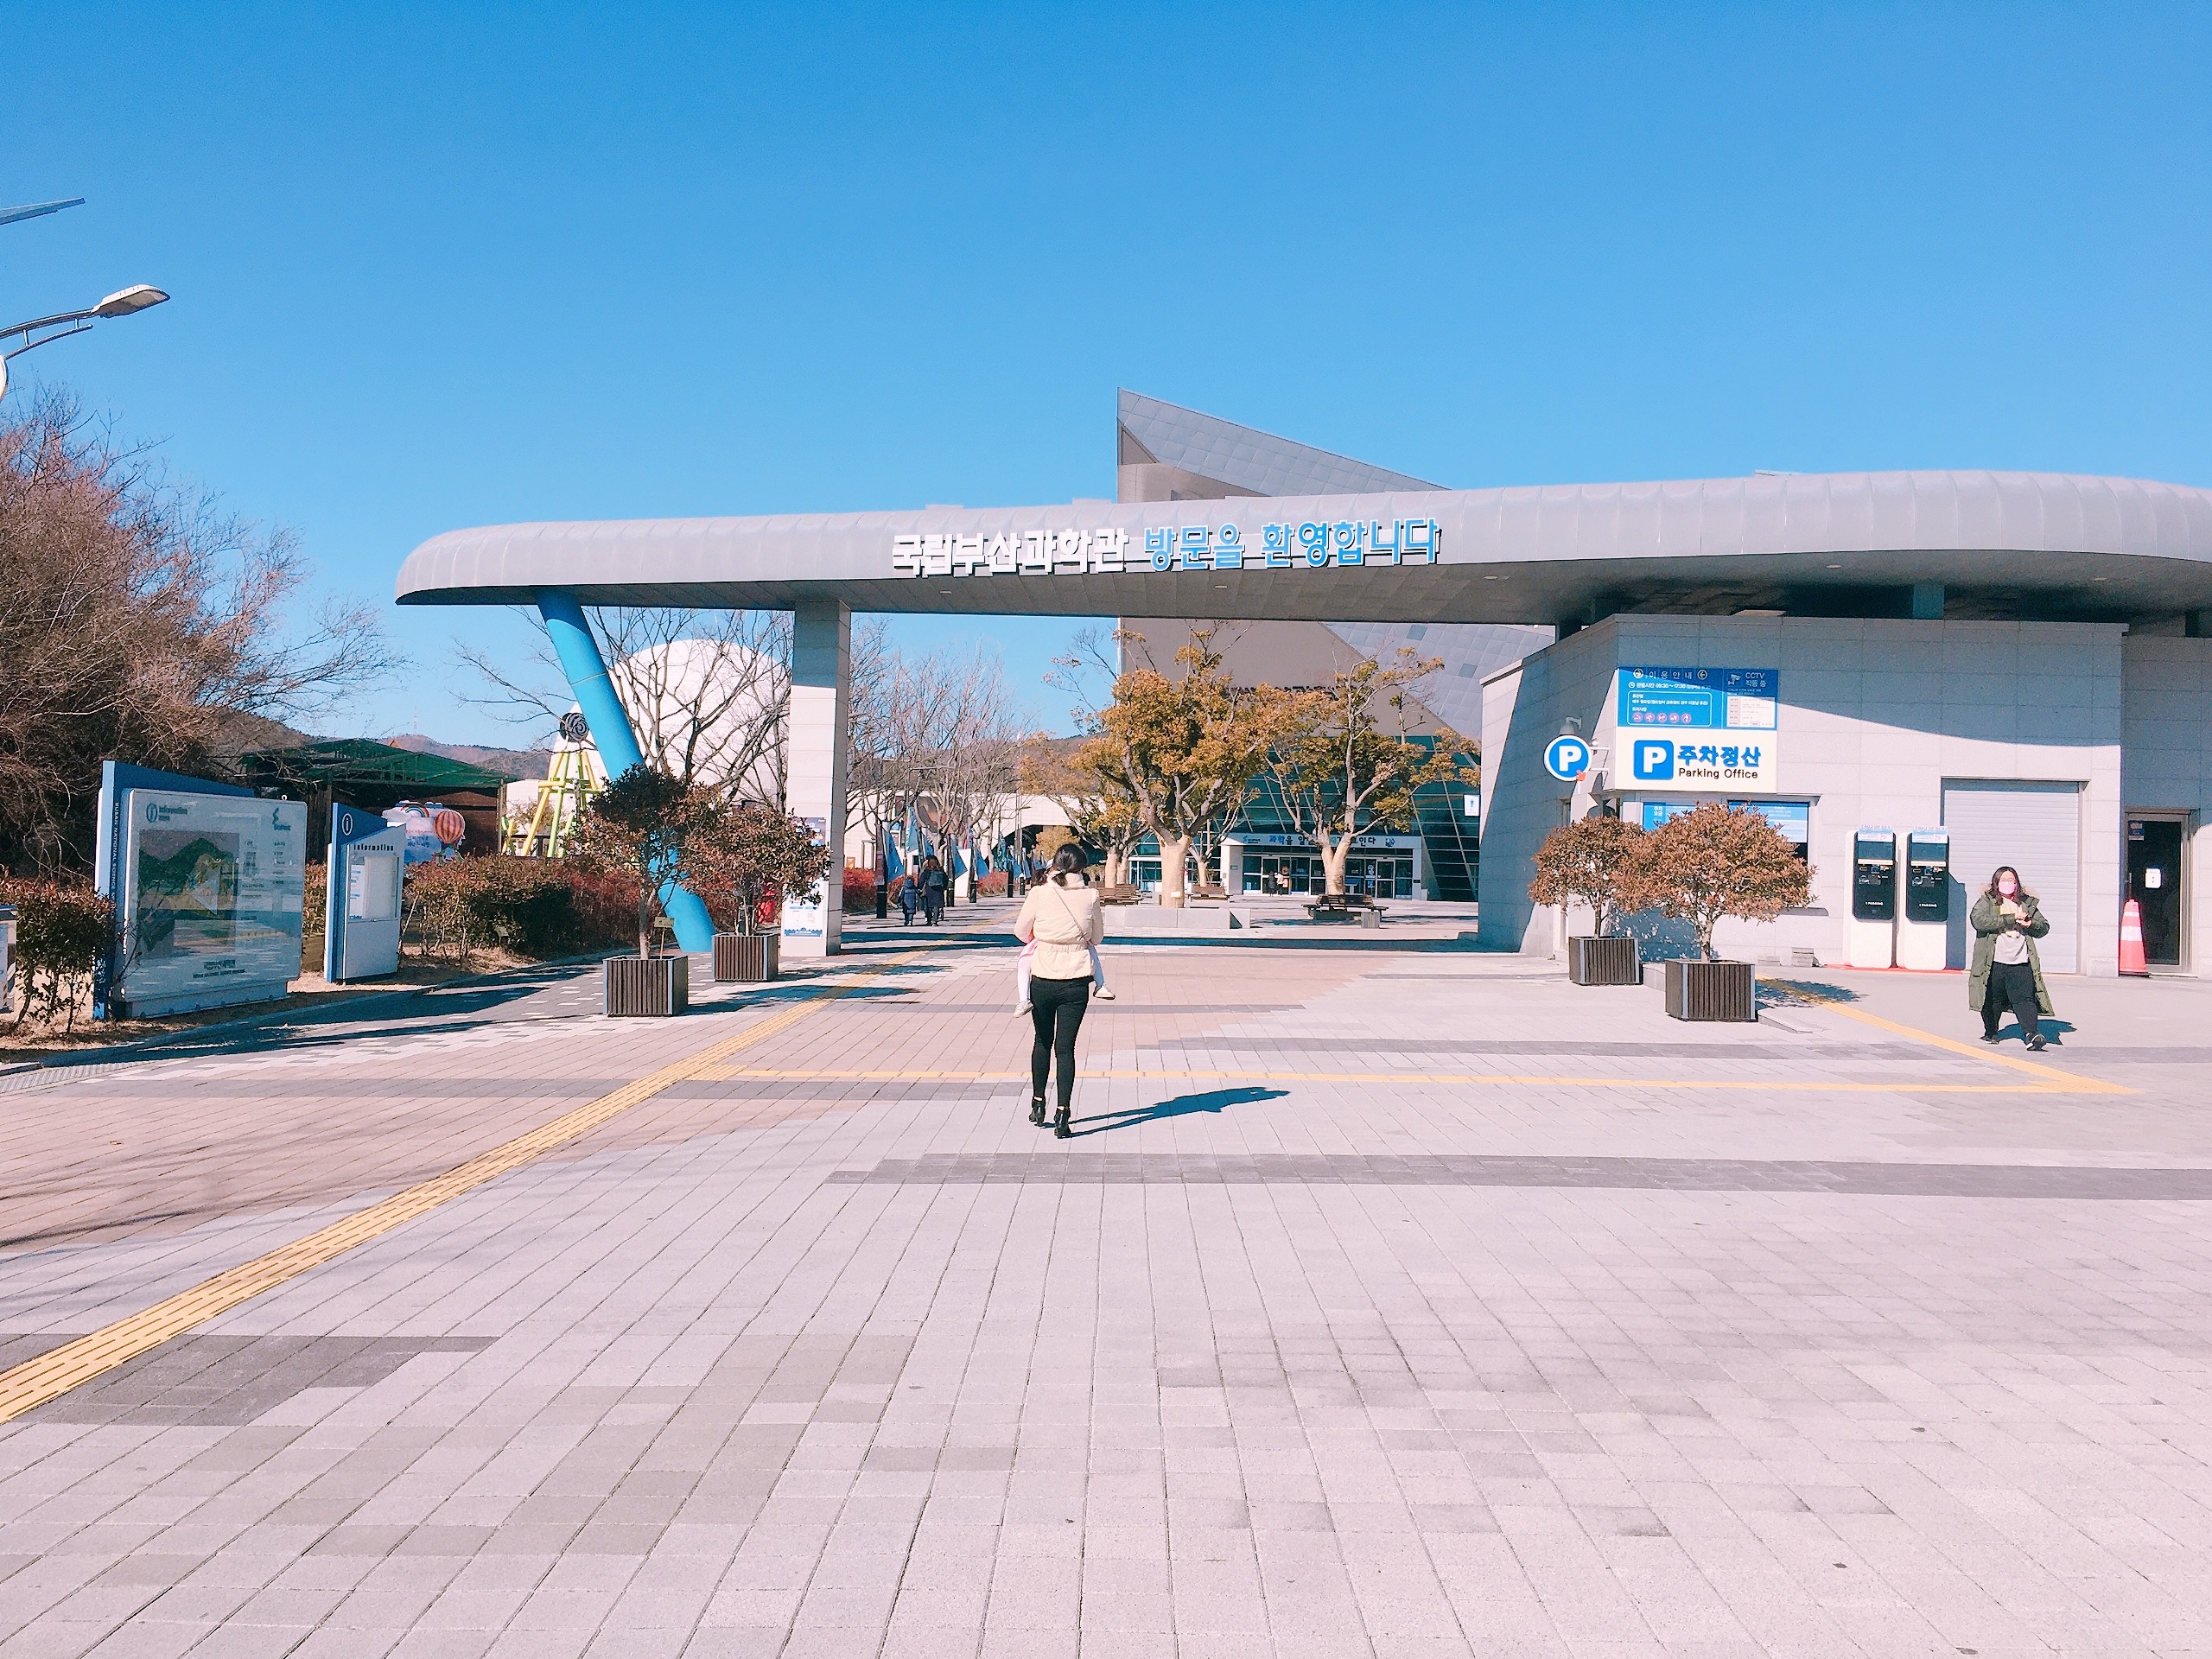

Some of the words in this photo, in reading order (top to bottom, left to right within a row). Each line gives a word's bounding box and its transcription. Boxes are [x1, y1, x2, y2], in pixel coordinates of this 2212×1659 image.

[893, 527, 1129, 575] 국립부산과학관
[1144, 523, 1243, 571] 방문을
[1261, 518, 1440, 569] 환영합니다
[1559, 746, 1582, 772] P
[1643, 747, 1667, 772] P
[1678, 746, 1761, 767] 주차정산
[1679, 767, 1719, 779] Parking
[1724, 768, 1758, 779] Office
